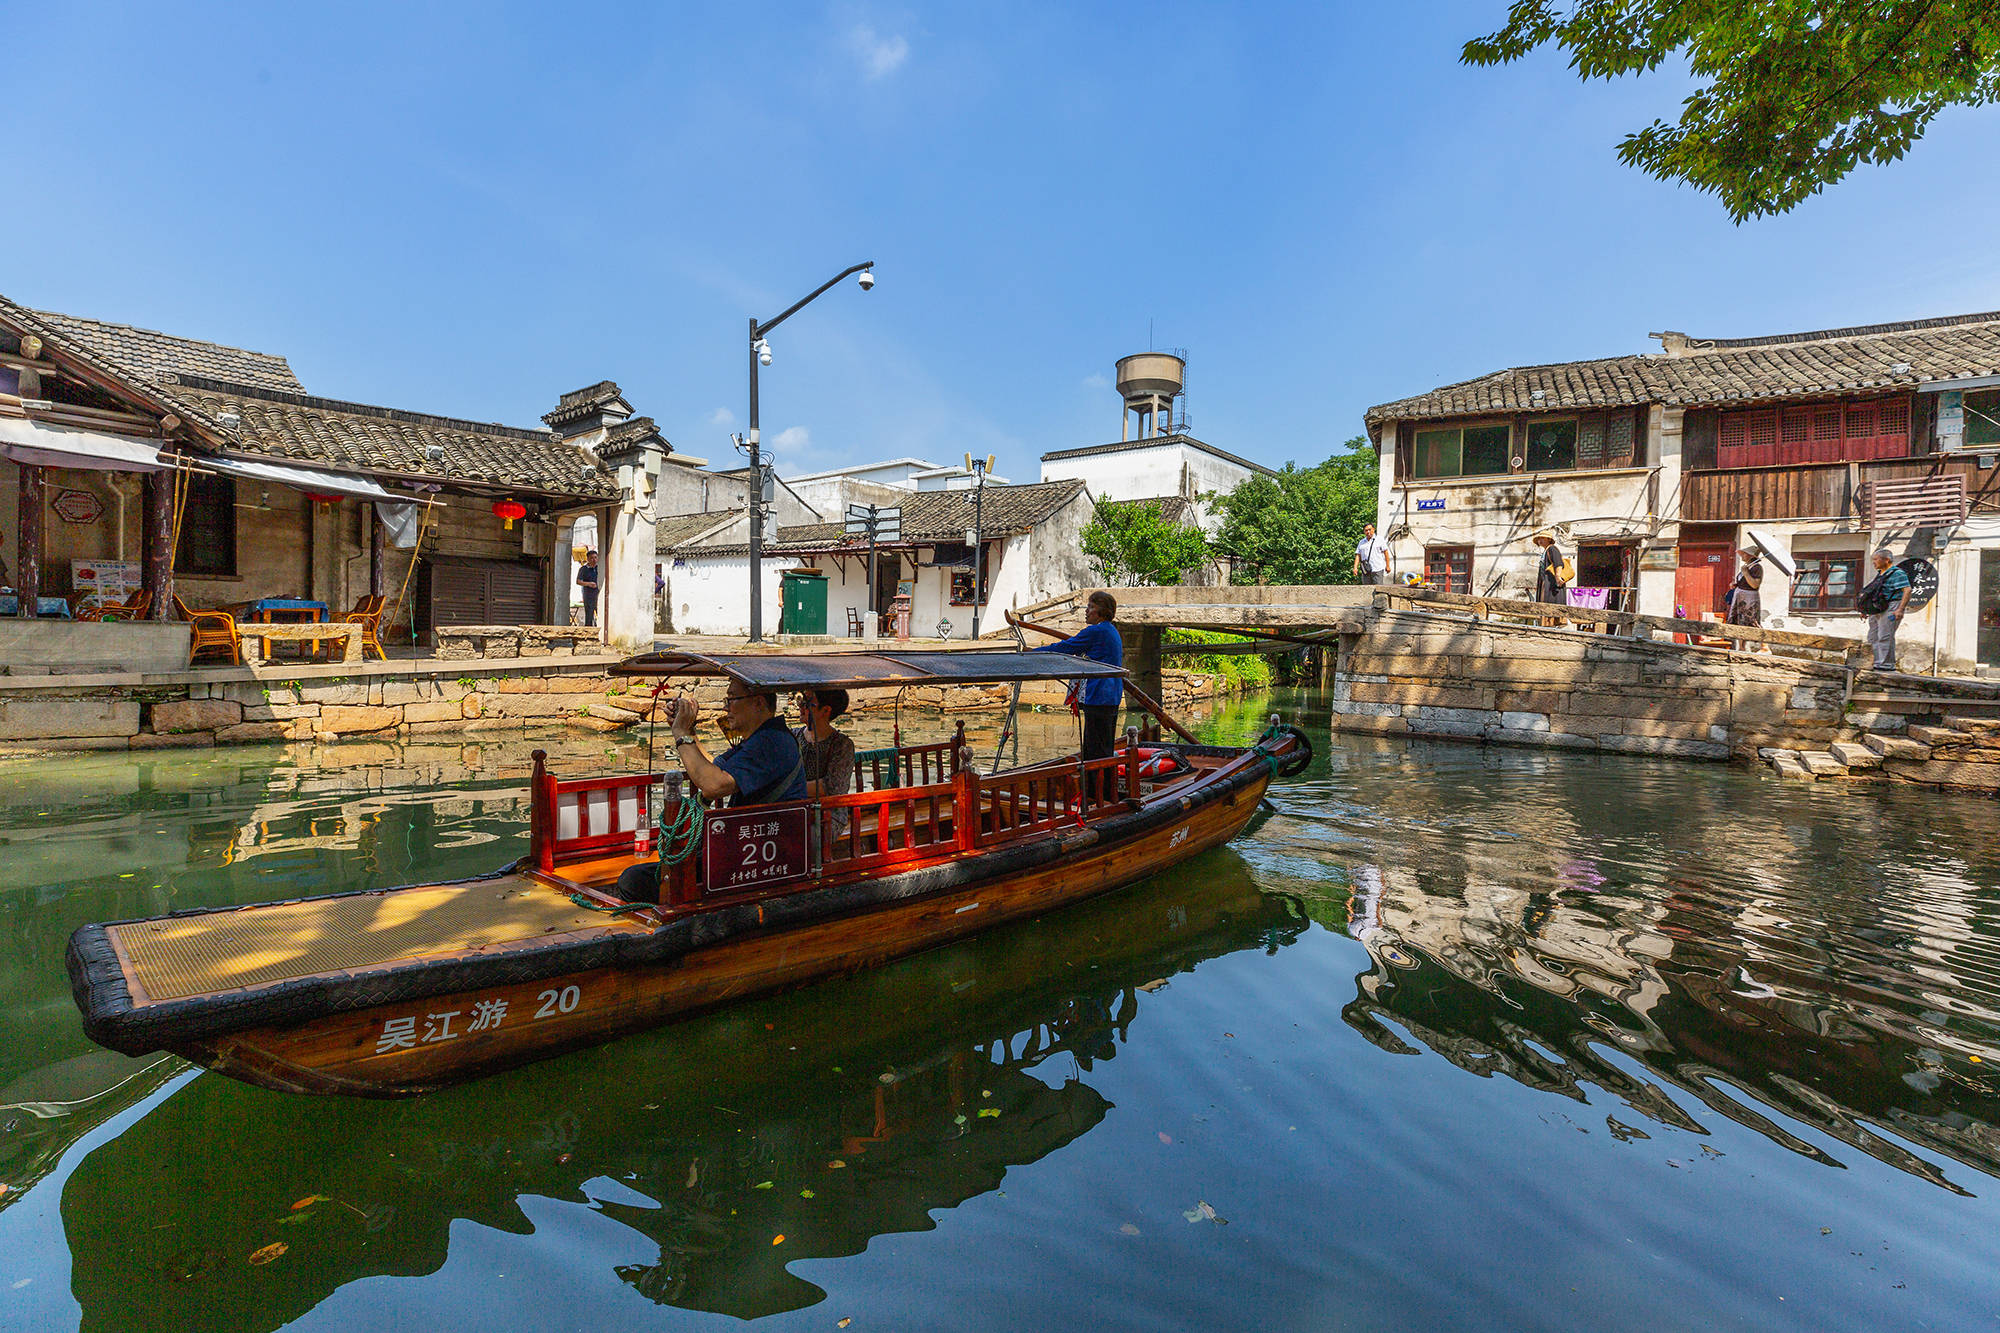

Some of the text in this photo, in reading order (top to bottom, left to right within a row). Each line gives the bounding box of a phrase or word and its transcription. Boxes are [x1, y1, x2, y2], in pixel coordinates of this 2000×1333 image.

[738, 821, 780, 841] 吴江游
[741, 840, 777, 866] 20
[375, 985, 581, 1054] 吴江游 20
